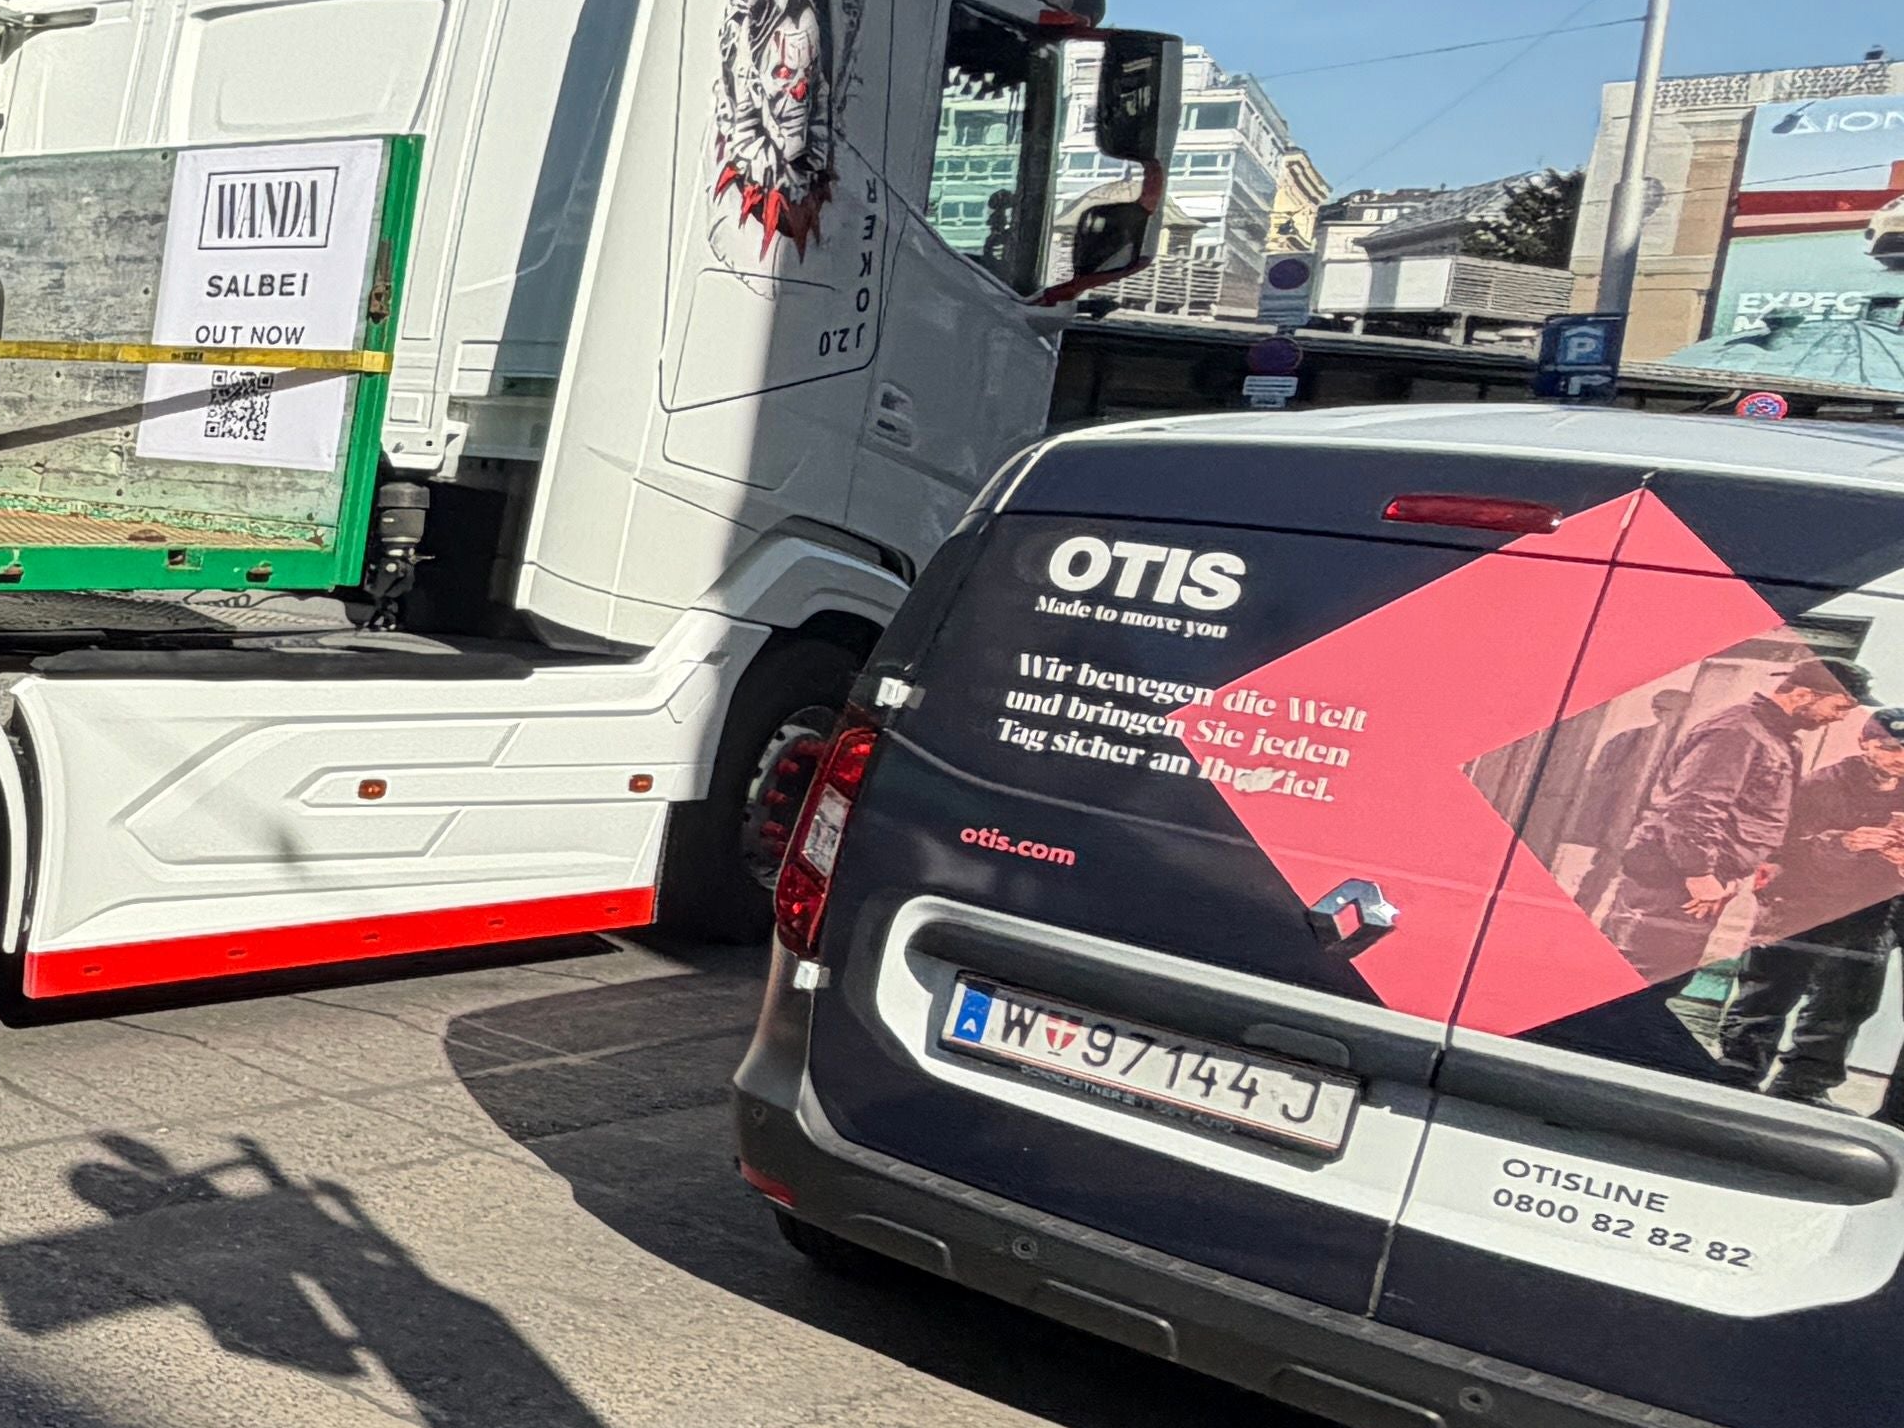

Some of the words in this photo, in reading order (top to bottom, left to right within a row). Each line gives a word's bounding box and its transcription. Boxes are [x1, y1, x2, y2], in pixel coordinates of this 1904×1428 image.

[217, 180, 318, 239] WANDA
[206, 273, 309, 298] SALBEI
[1737, 291, 1863, 314] EXPEC
[195, 325, 242, 345] OUT
[250, 325, 305, 345] NOW
[1048, 536, 1247, 611] OTIS
[1034, 595, 1092, 619] Made
[1096, 604, 1118, 622] to
[1121, 612, 1182, 633] move
[1185, 620, 1228, 639] you
[1019, 652, 1073, 684] Wir
[1076, 662, 1215, 707] bewegen
[1223, 689, 1278, 717] die
[1289, 696, 1369, 733] Welt
[998, 716, 1047, 753] Tag
[1050, 730, 1146, 767] sicher
[1149, 750, 1191, 776] an
[1005, 690, 1063, 716] und
[1067, 696, 1186, 739] bringen
[1192, 718, 1245, 748] Sie
[1248, 728, 1351, 768] jeden
[960, 826, 1076, 867] otis.com
[1000, 1000, 1041, 1048] W
[1502, 1158, 1670, 1213] OTISLINE
[1493, 1188, 1579, 1224] 0800
[1591, 1213, 1635, 1239] 82
[1647, 1227, 1693, 1254] 82
[1705, 1241, 1752, 1268] 82
